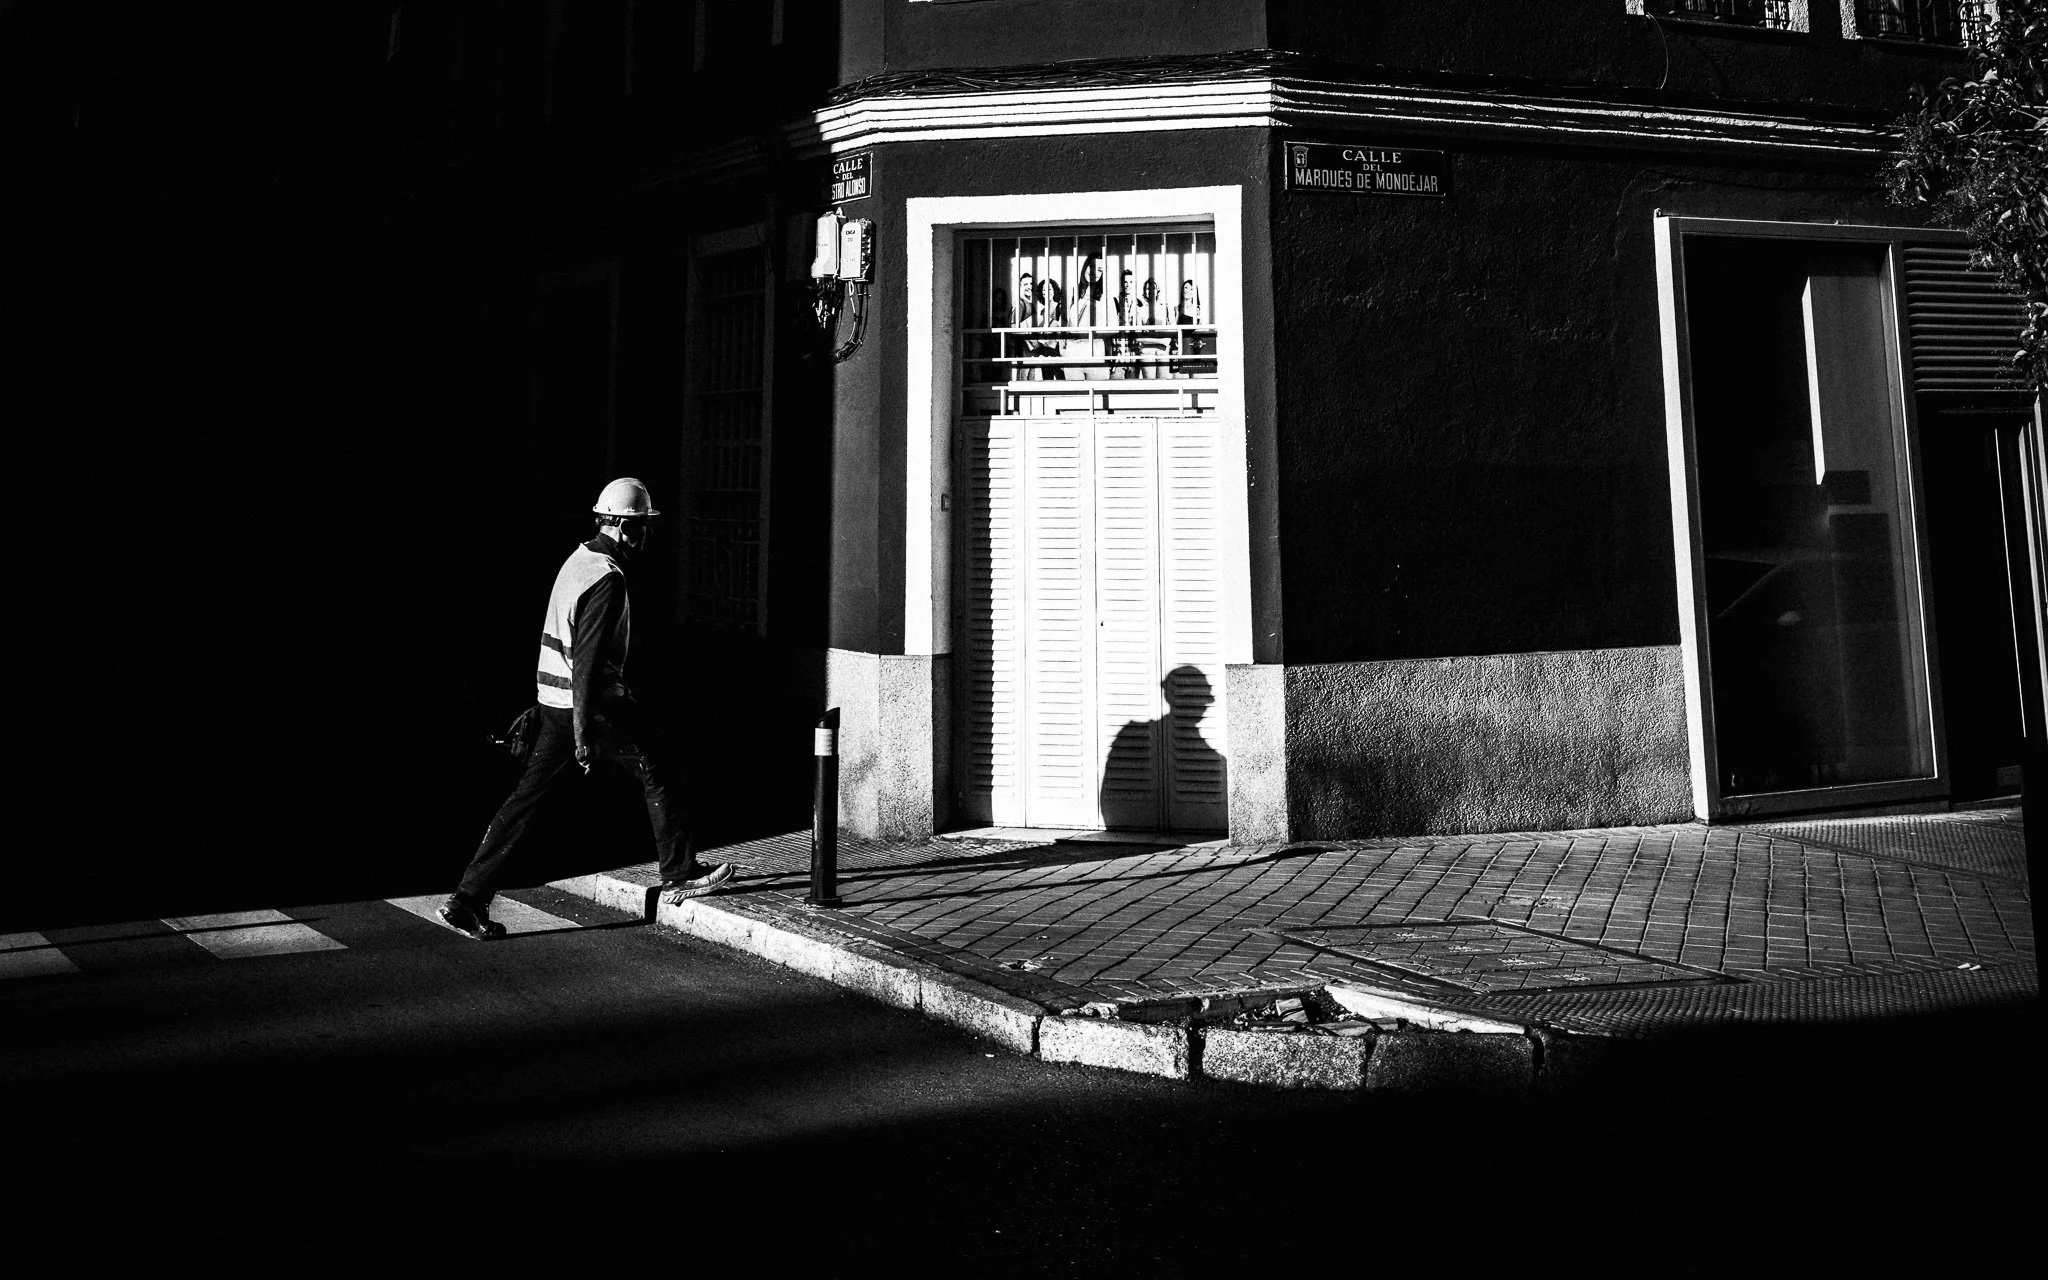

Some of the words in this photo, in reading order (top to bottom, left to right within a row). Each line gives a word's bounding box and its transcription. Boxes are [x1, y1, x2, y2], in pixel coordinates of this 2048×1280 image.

[1342, 149, 1402, 164] CALLE
[833, 158, 863, 174] CALLE
[1363, 163, 1383, 172] DEL
[842, 172, 854, 181] DEL
[1295, 168, 1352, 188] MARQUÉS
[1357, 173, 1371, 189] DE
[1376, 171, 1438, 192] MONDÉJAR
[832, 182, 845, 200] STRO
[846, 177, 866, 197] ALONSO
